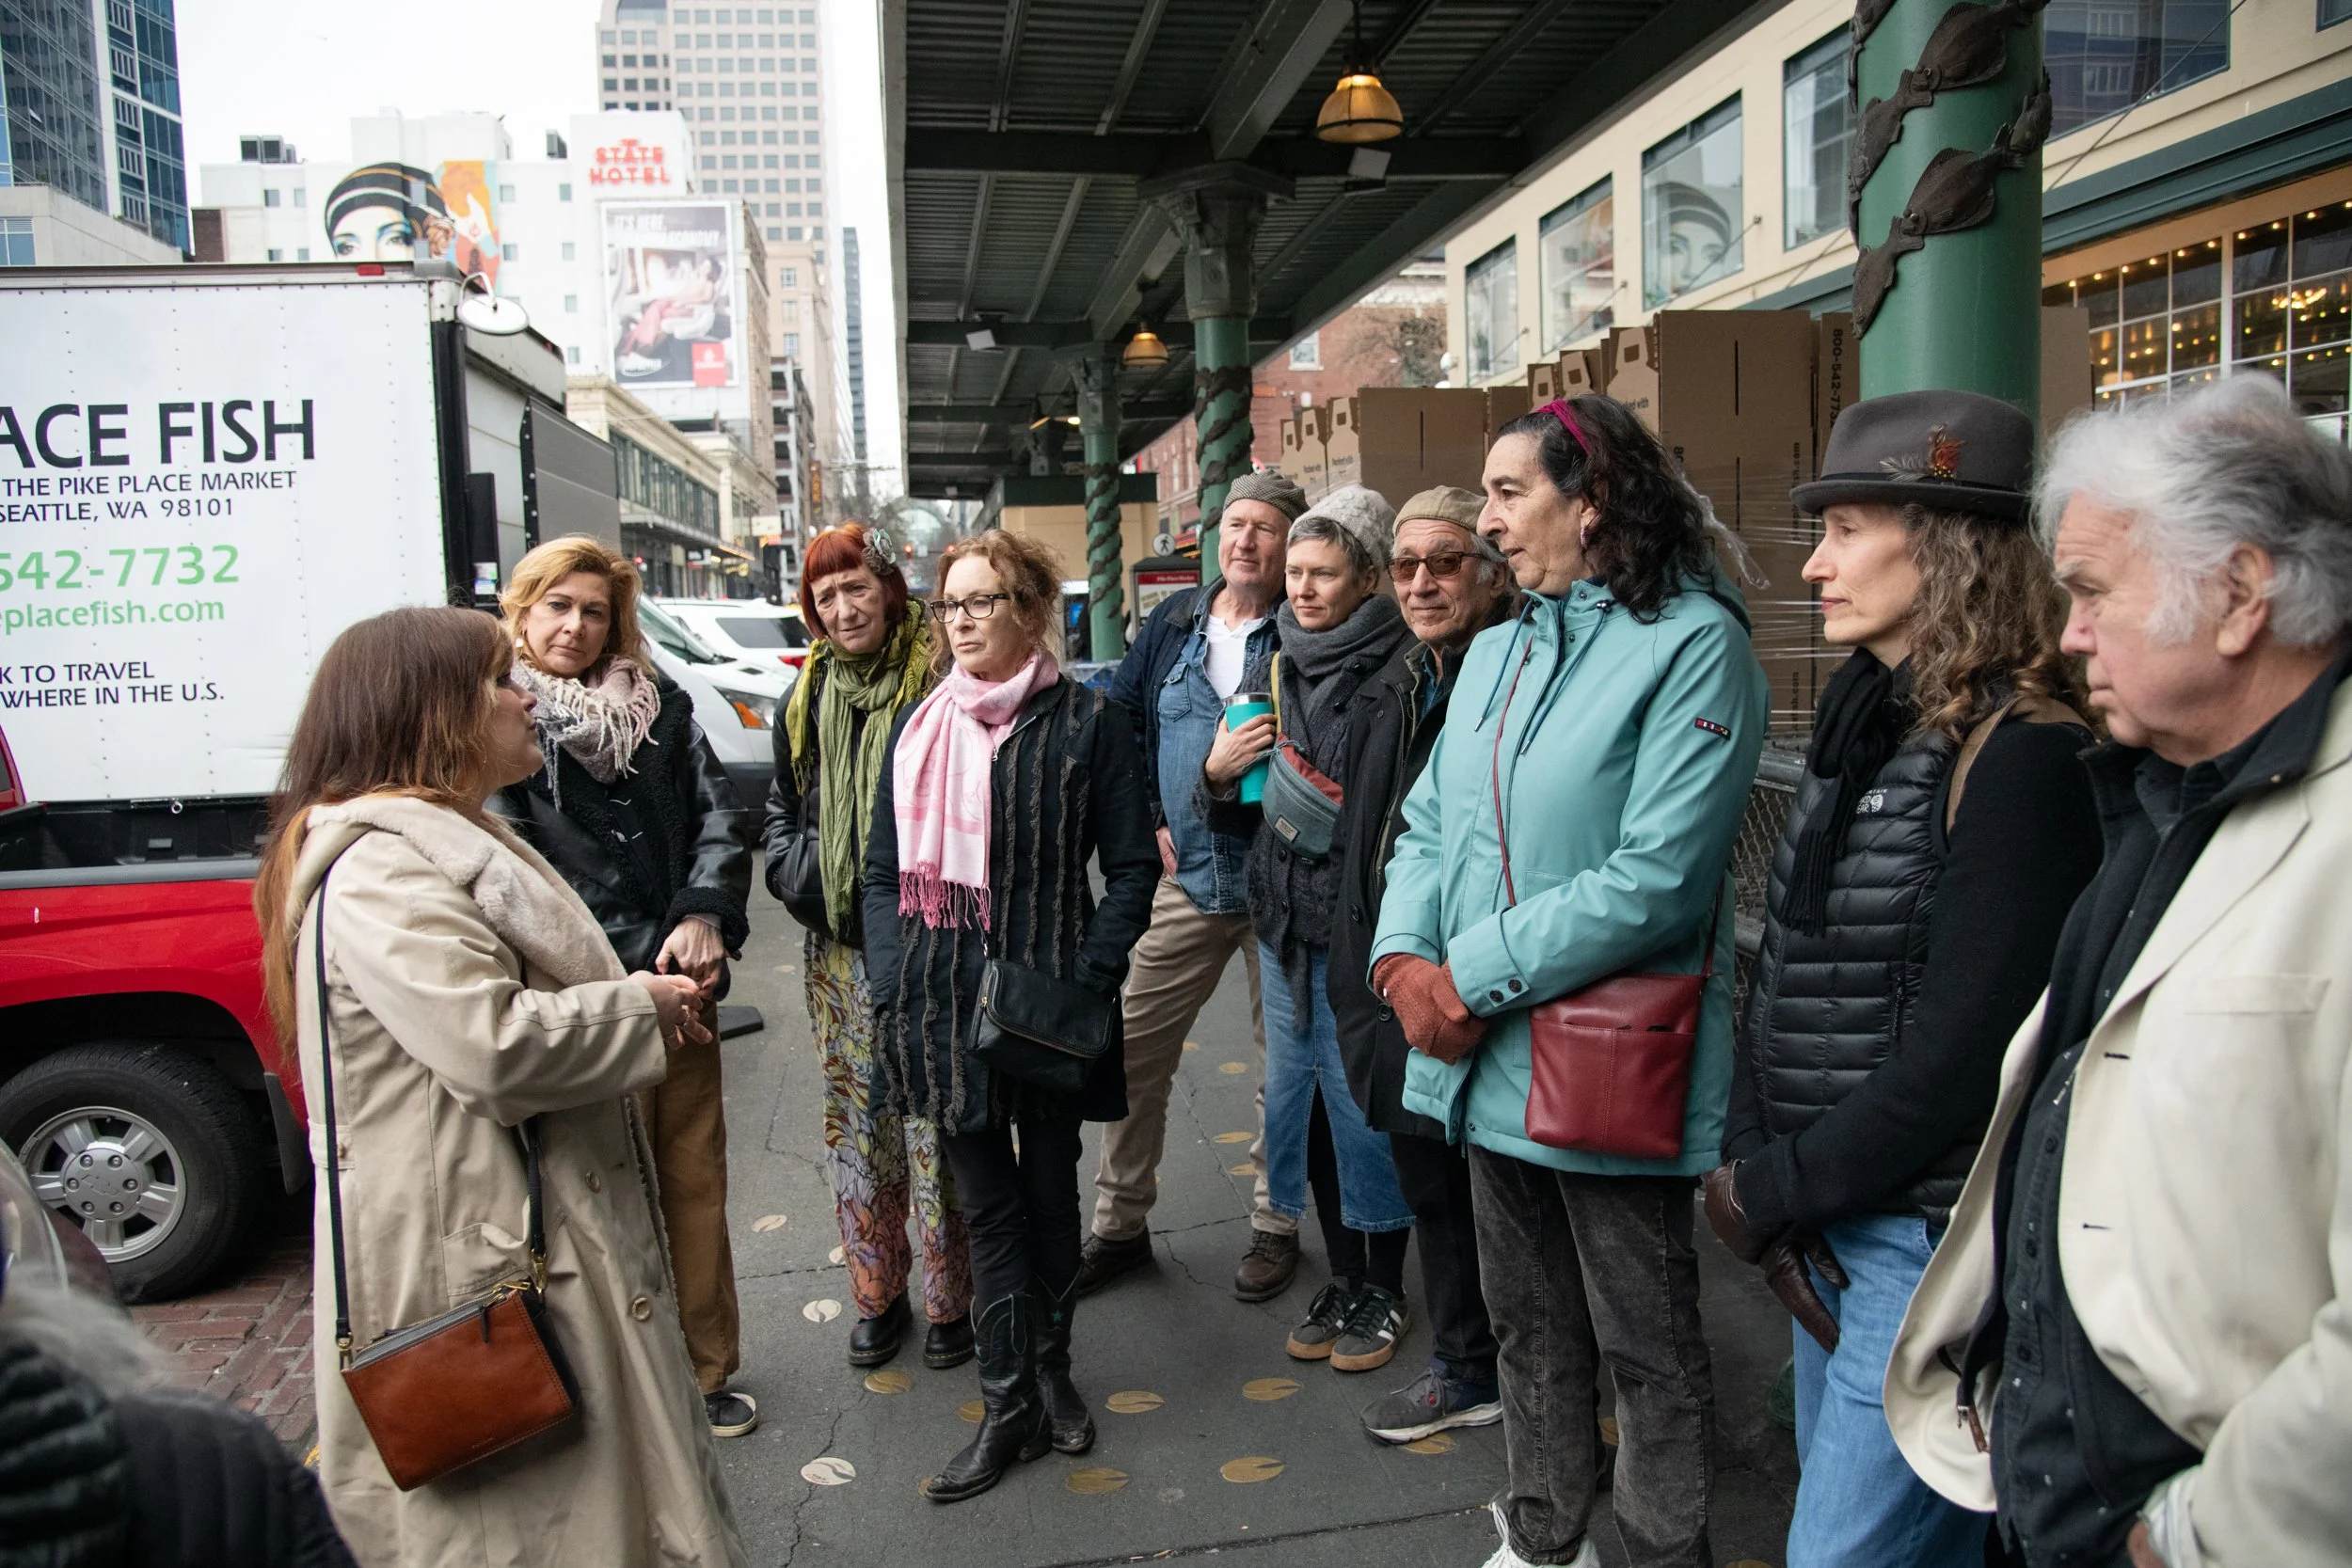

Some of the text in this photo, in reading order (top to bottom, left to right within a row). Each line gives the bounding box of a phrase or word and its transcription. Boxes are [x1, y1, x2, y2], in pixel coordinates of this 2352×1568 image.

[595, 146, 663, 164] STATE
[589, 166, 670, 184] HOTEL
[158, 399, 315, 465] FISH
[2, 470, 297, 497] THE PIKE PLACE MARKET
[106, 500, 148, 519] WA
[161, 498, 233, 518] 98101
[0, 600, 225, 636] placefish.com
[21, 664, 56, 684] TO
[63, 661, 155, 682] TRAVEL
[96, 686, 120, 705] IN
[127, 684, 173, 704] THE
[182, 682, 225, 702] U.S.
